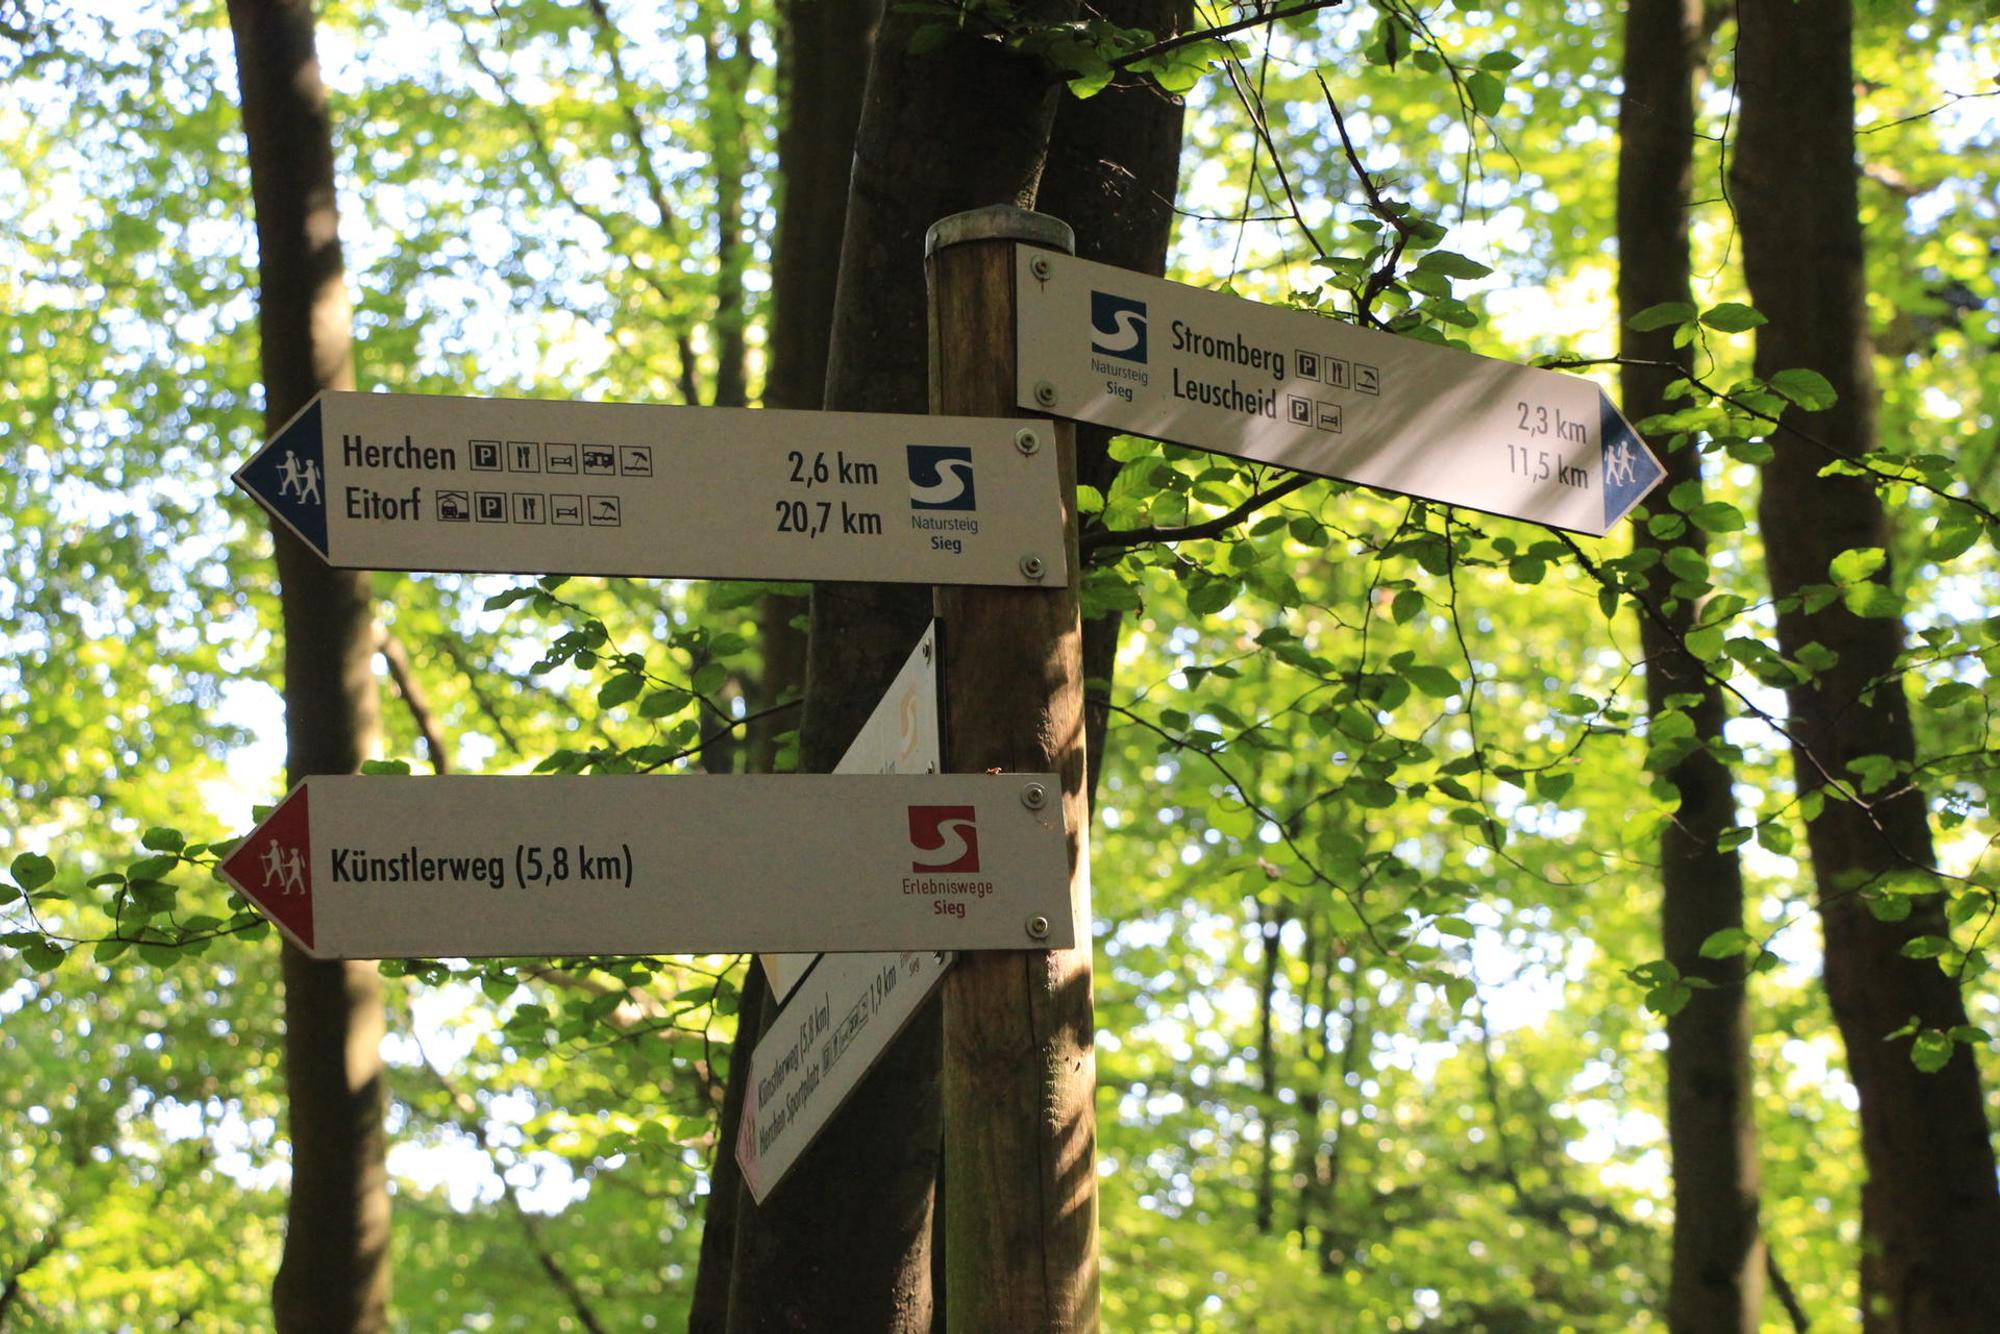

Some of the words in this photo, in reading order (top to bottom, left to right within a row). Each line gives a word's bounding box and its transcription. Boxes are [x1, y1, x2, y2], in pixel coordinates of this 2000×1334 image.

[1091, 358, 1148, 386] Natursteig
[1171, 319, 1285, 381] Stromberg
[1517, 401, 1548, 438] 2,3
[1556, 408, 1587, 444] km
[1106, 381, 1133, 402] Sieg
[1173, 367, 1277, 419] Leuscheid
[1507, 444, 1550, 483] 11,5
[1558, 454, 1589, 490] km
[343, 435, 456, 471] Herchen
[788, 450, 829, 489] 2,6
[837, 451, 878, 485] km
[346, 486, 421, 521] Eitorf
[775, 500, 832, 539] 20,7
[841, 501, 882, 535] km
[911, 515, 978, 534] Natursteig
[931, 536, 962, 554] Sieg
[331, 845, 504, 889] Künstlerweg
[515, 844, 569, 889] (5,8
[578, 843, 632, 889] km)
[902, 878, 993, 898] Erlebniswege
[934, 900, 966, 918] Sieg
[870, 974, 882, 1016] 1,9
[883, 965, 897, 998] km
